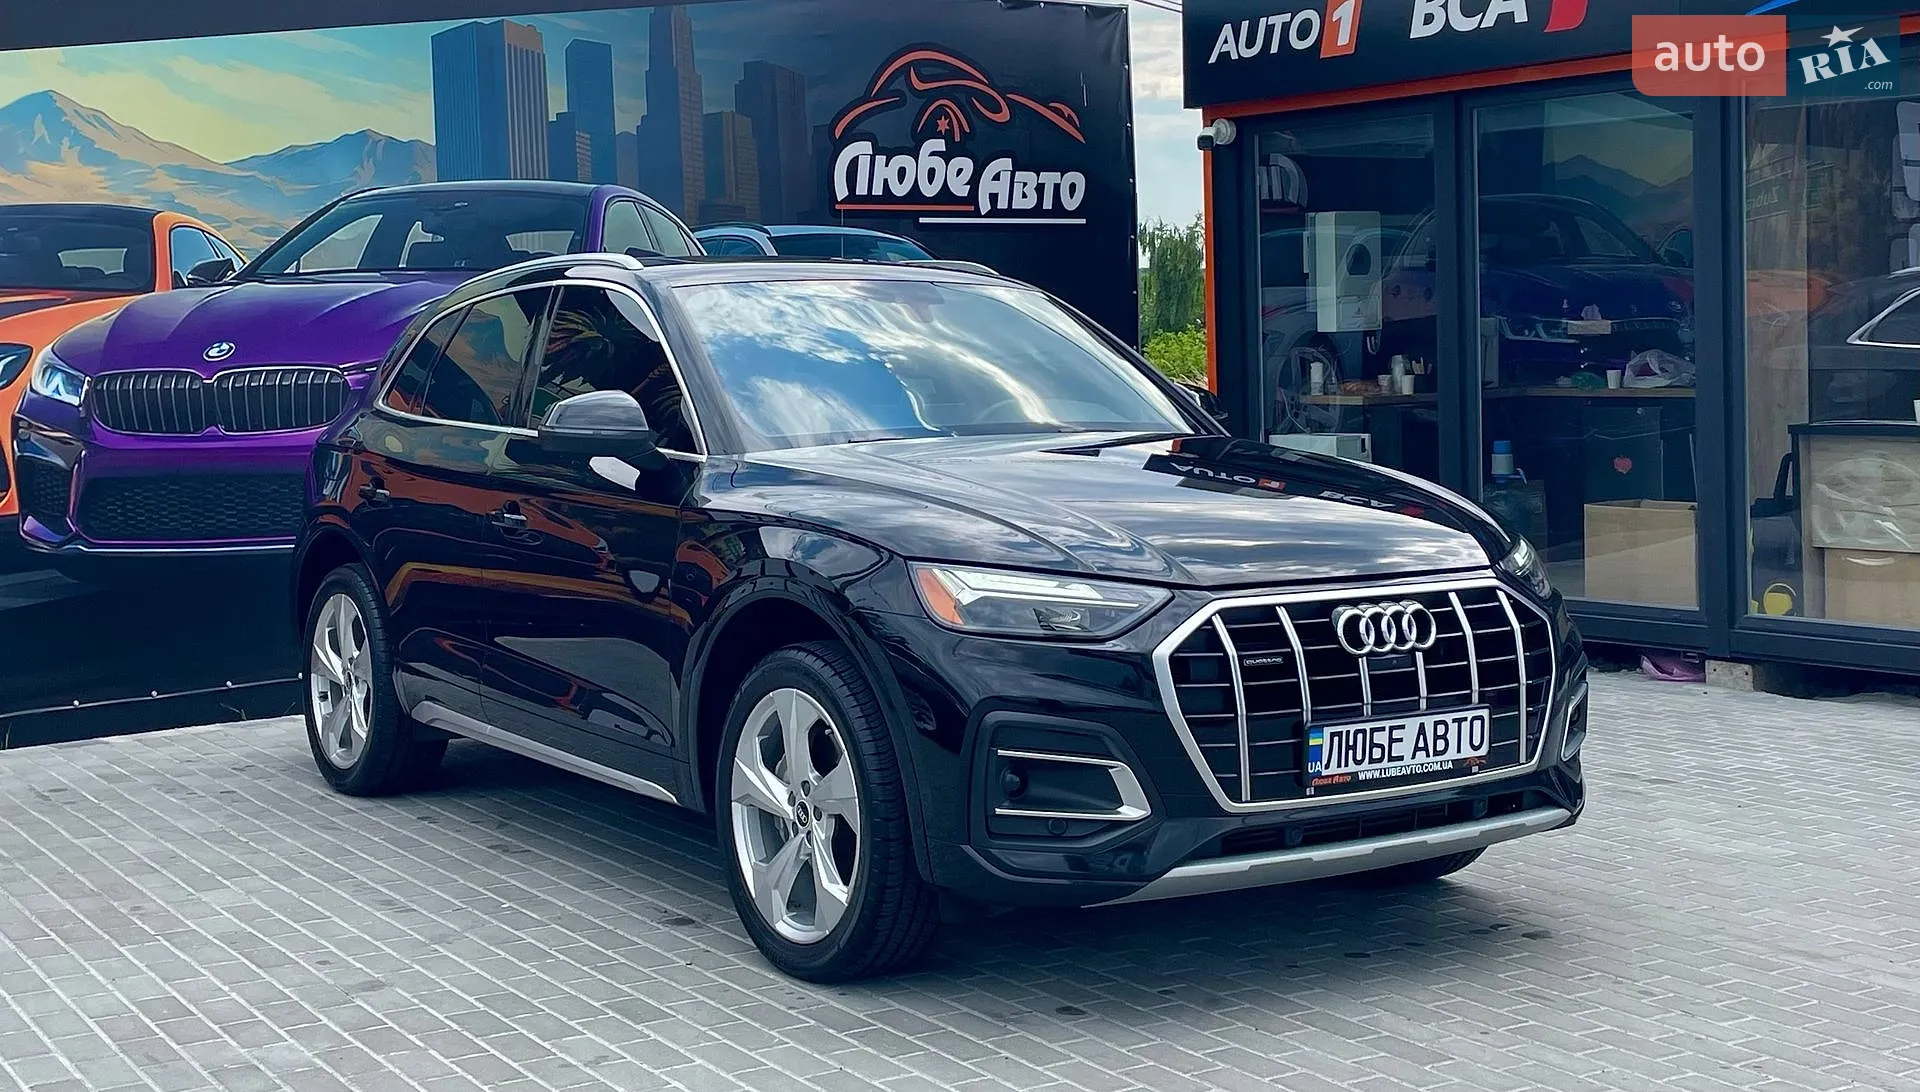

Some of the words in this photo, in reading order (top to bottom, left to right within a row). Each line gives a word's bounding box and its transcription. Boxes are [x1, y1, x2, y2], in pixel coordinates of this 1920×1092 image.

[834, 138, 974, 202] Любе
[978, 157, 1086, 216] Авто
[1325, 724, 1406, 770] ЛЮБЕ
[1411, 715, 1486, 760] АВТО
[1307, 761, 1322, 774] UA
[1358, 760, 1453, 781] WWW.LUBEAVTO.COM.UA
